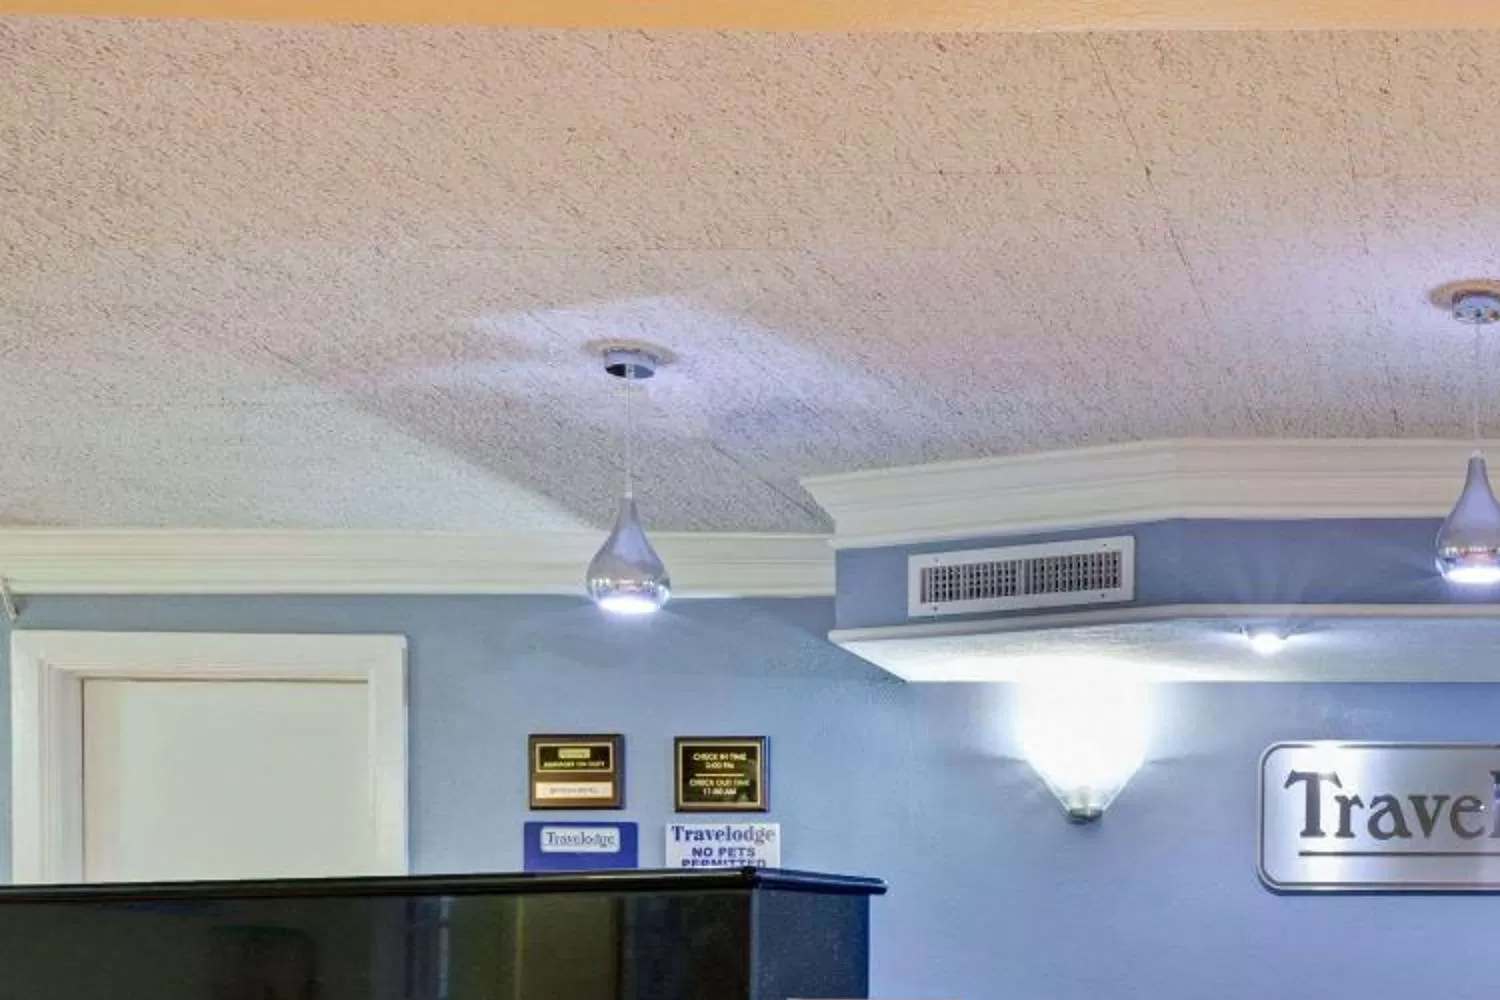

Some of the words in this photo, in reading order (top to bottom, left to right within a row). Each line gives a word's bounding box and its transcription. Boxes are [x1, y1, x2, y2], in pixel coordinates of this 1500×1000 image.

[545, 831, 615, 849] Travelodge
[671, 825, 775, 845] Travelodge
[691, 847, 713, 857] NO
[718, 847, 756, 857] PETS
[681, 859, 767, 868] PERMITTED
